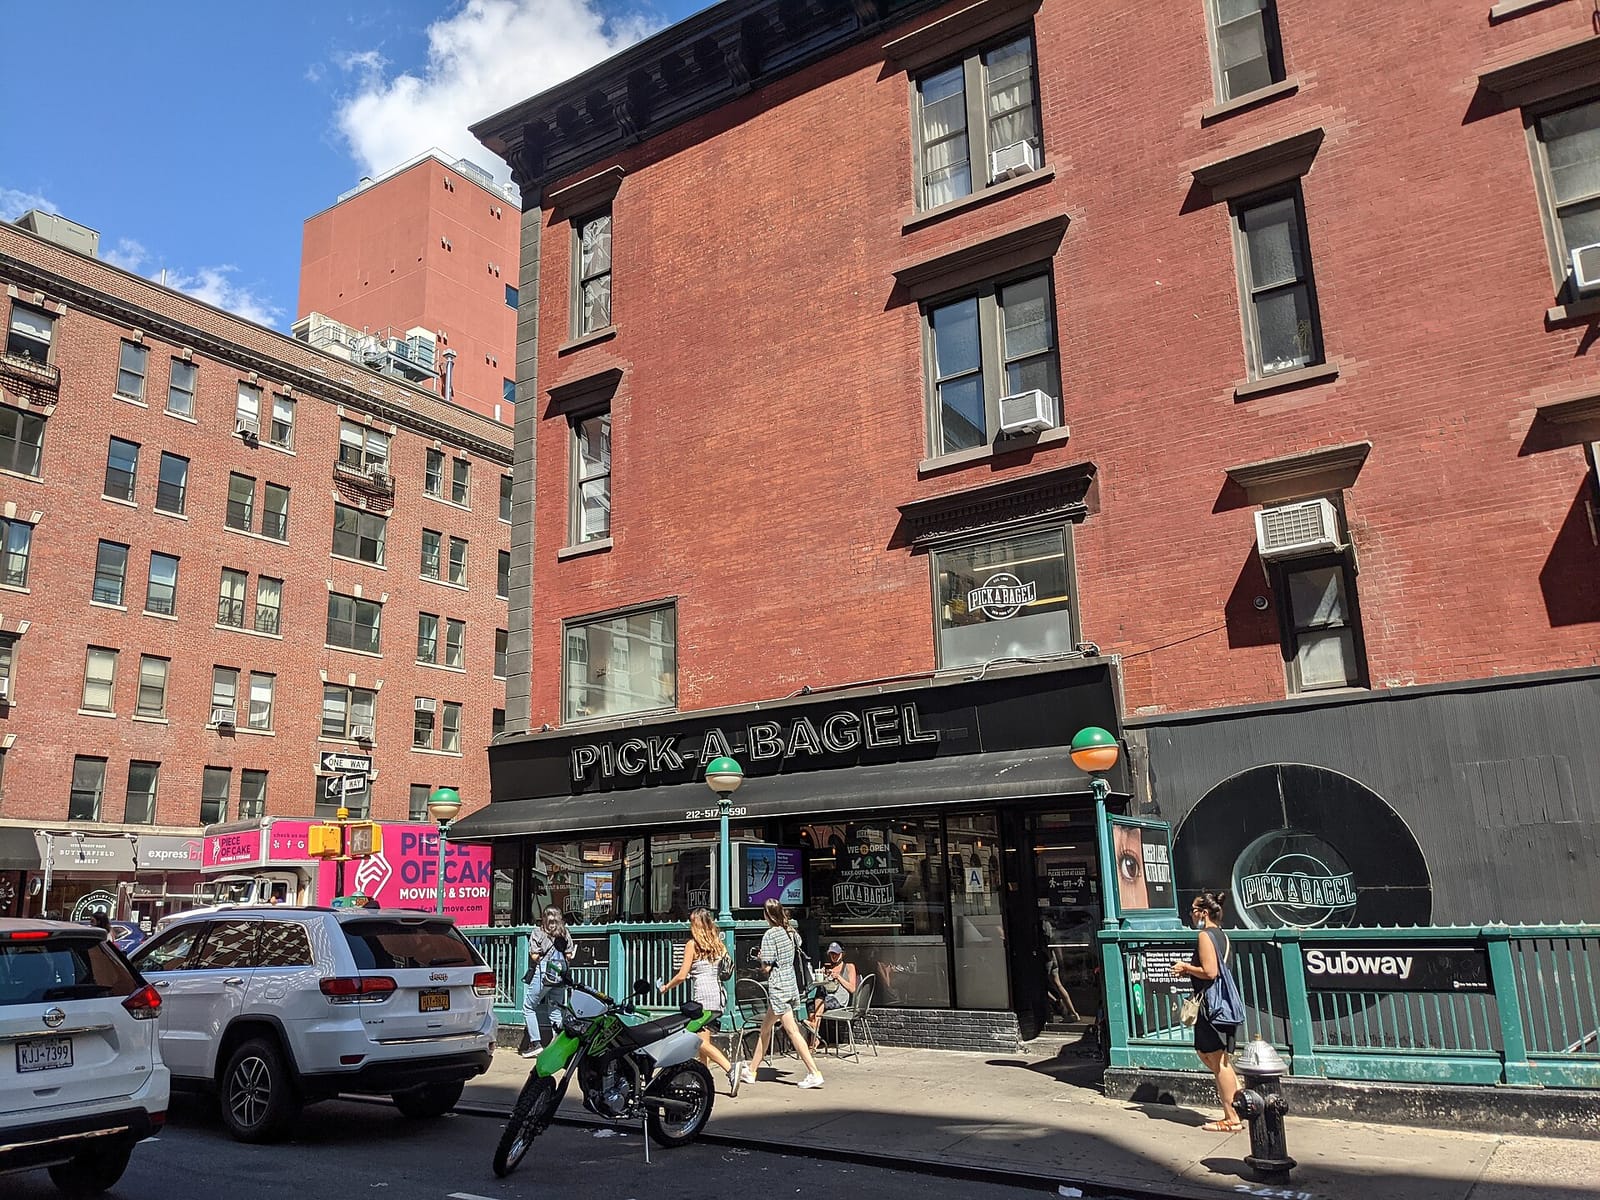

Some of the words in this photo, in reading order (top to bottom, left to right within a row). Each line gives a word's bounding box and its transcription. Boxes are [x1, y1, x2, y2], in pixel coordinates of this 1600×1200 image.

[972, 588, 994, 608] PICK
[995, 588, 1001, 604] A
[1002, 585, 1034, 604] BAGEL
[572, 702, 942, 782] PICK-A-BAGEL
[329, 758, 344, 767] ONE
[350, 760, 366, 769] WAY
[350, 779, 361, 788] WAY
[686, 807, 747, 819] 212-517-590
[221, 836, 241, 847] PIECE
[221, 847, 231, 857] OF
[231, 845, 251, 855] CAKE
[847, 845, 859, 854] WE
[869, 844, 890, 852] OPEN
[401, 860, 437, 884] OF
[969, 870, 981, 885] A
[400, 888, 446, 899] MOVIN
[448, 888, 456, 898] &
[835, 885, 855, 902] PICK
[864, 885, 893, 904] BAGEL
[1244, 876, 1284, 904] PICK
[1287, 877, 1299, 900] A
[1301, 877, 1357, 904] BAGEL
[689, 890, 707, 907] PICK
[1306, 950, 1413, 979] Subway
[429, 972, 448, 982] Jeep
